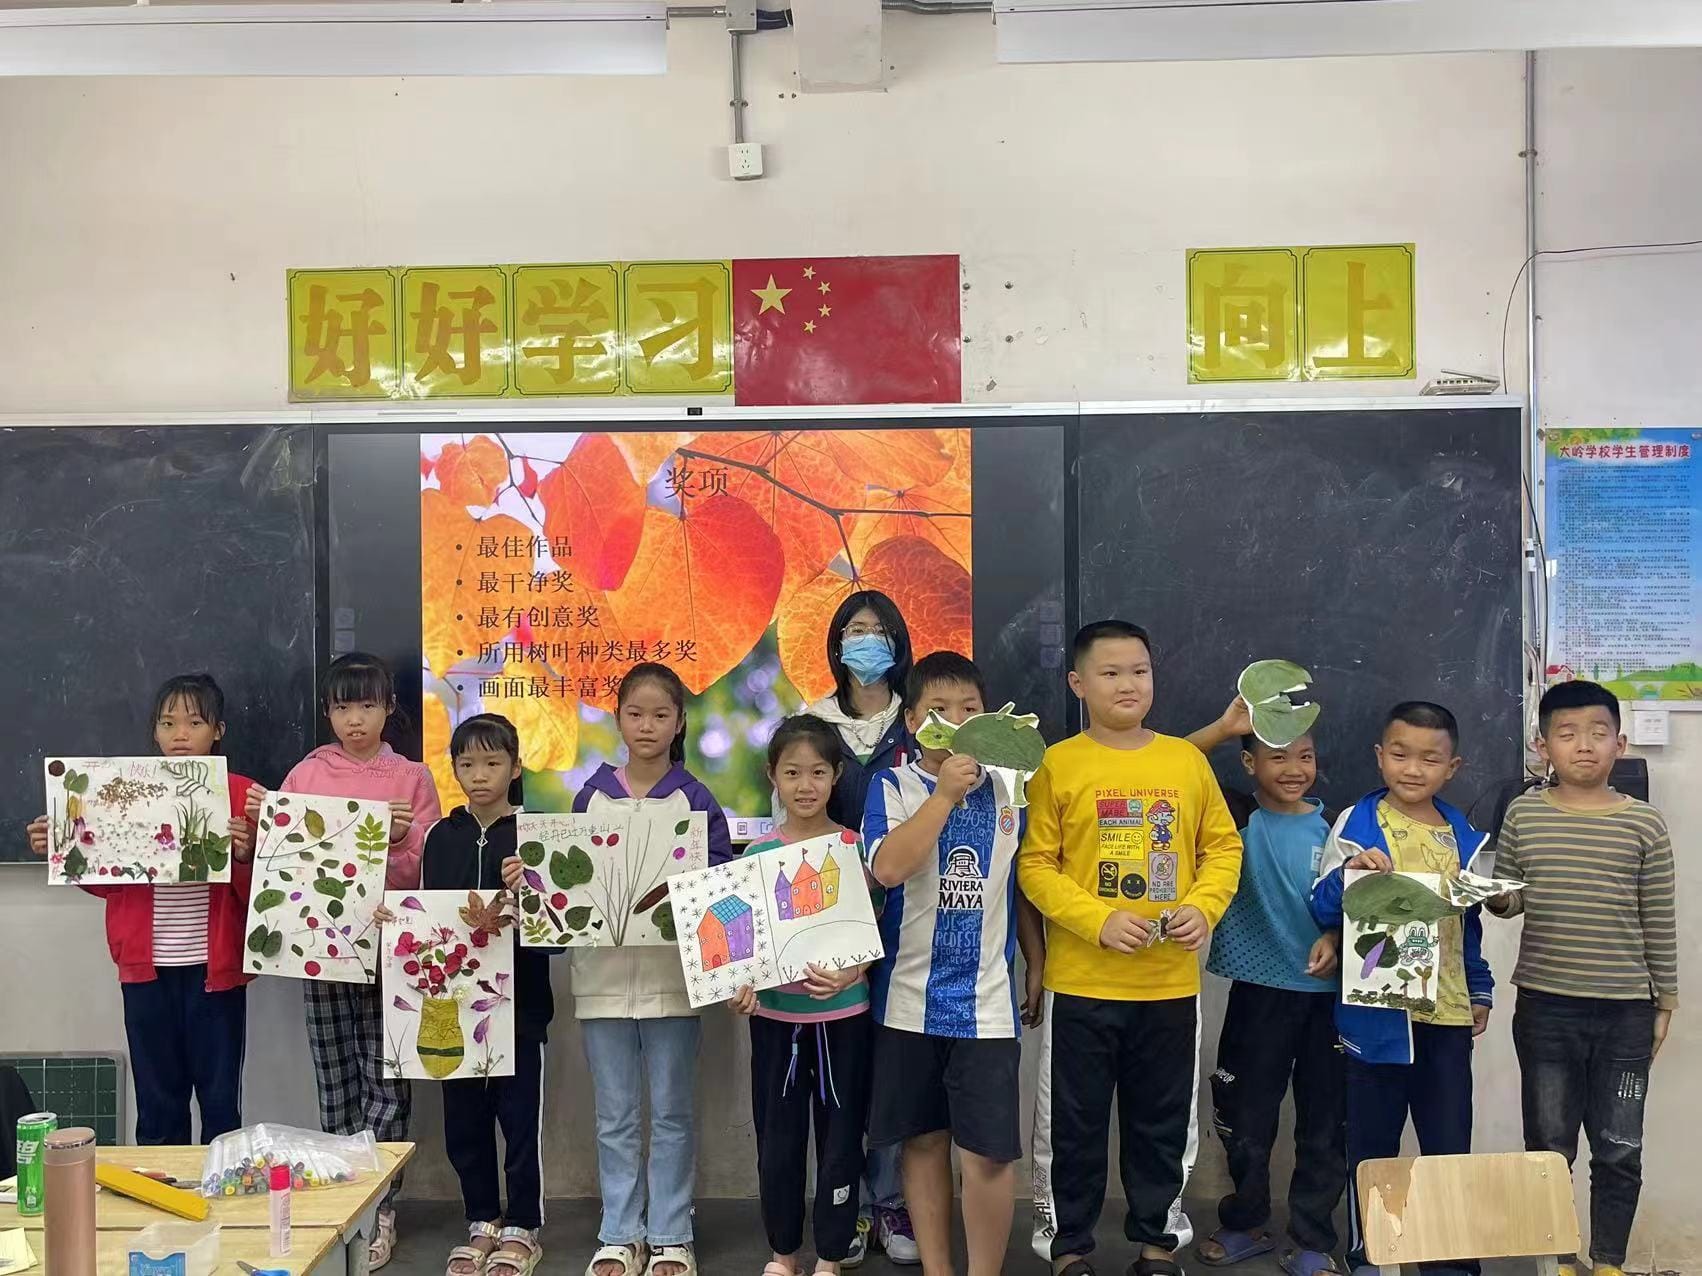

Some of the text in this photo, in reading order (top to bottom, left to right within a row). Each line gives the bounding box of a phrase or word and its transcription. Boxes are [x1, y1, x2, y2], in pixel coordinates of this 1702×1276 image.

[299, 261, 1401, 387] 好好学习 向上
[1559, 444, 1691, 459] 大岭学校学生管理制度
[664, 466, 729, 499] 奖项
[476, 535, 573, 559] 最佳作品
[477, 570, 575, 594] 最干净奖
[477, 605, 600, 629] 最有创意奖
[477, 639, 698, 664] 所用树叶种类最多奖
[478, 676, 624, 699] 画面最丰富奖
[1095, 789, 1180, 798] PIXEL UNIVERSE
[1101, 833, 1131, 842] SMILE
[939, 878, 984, 892] RIVIERA
[938, 891, 984, 909] MAYA
